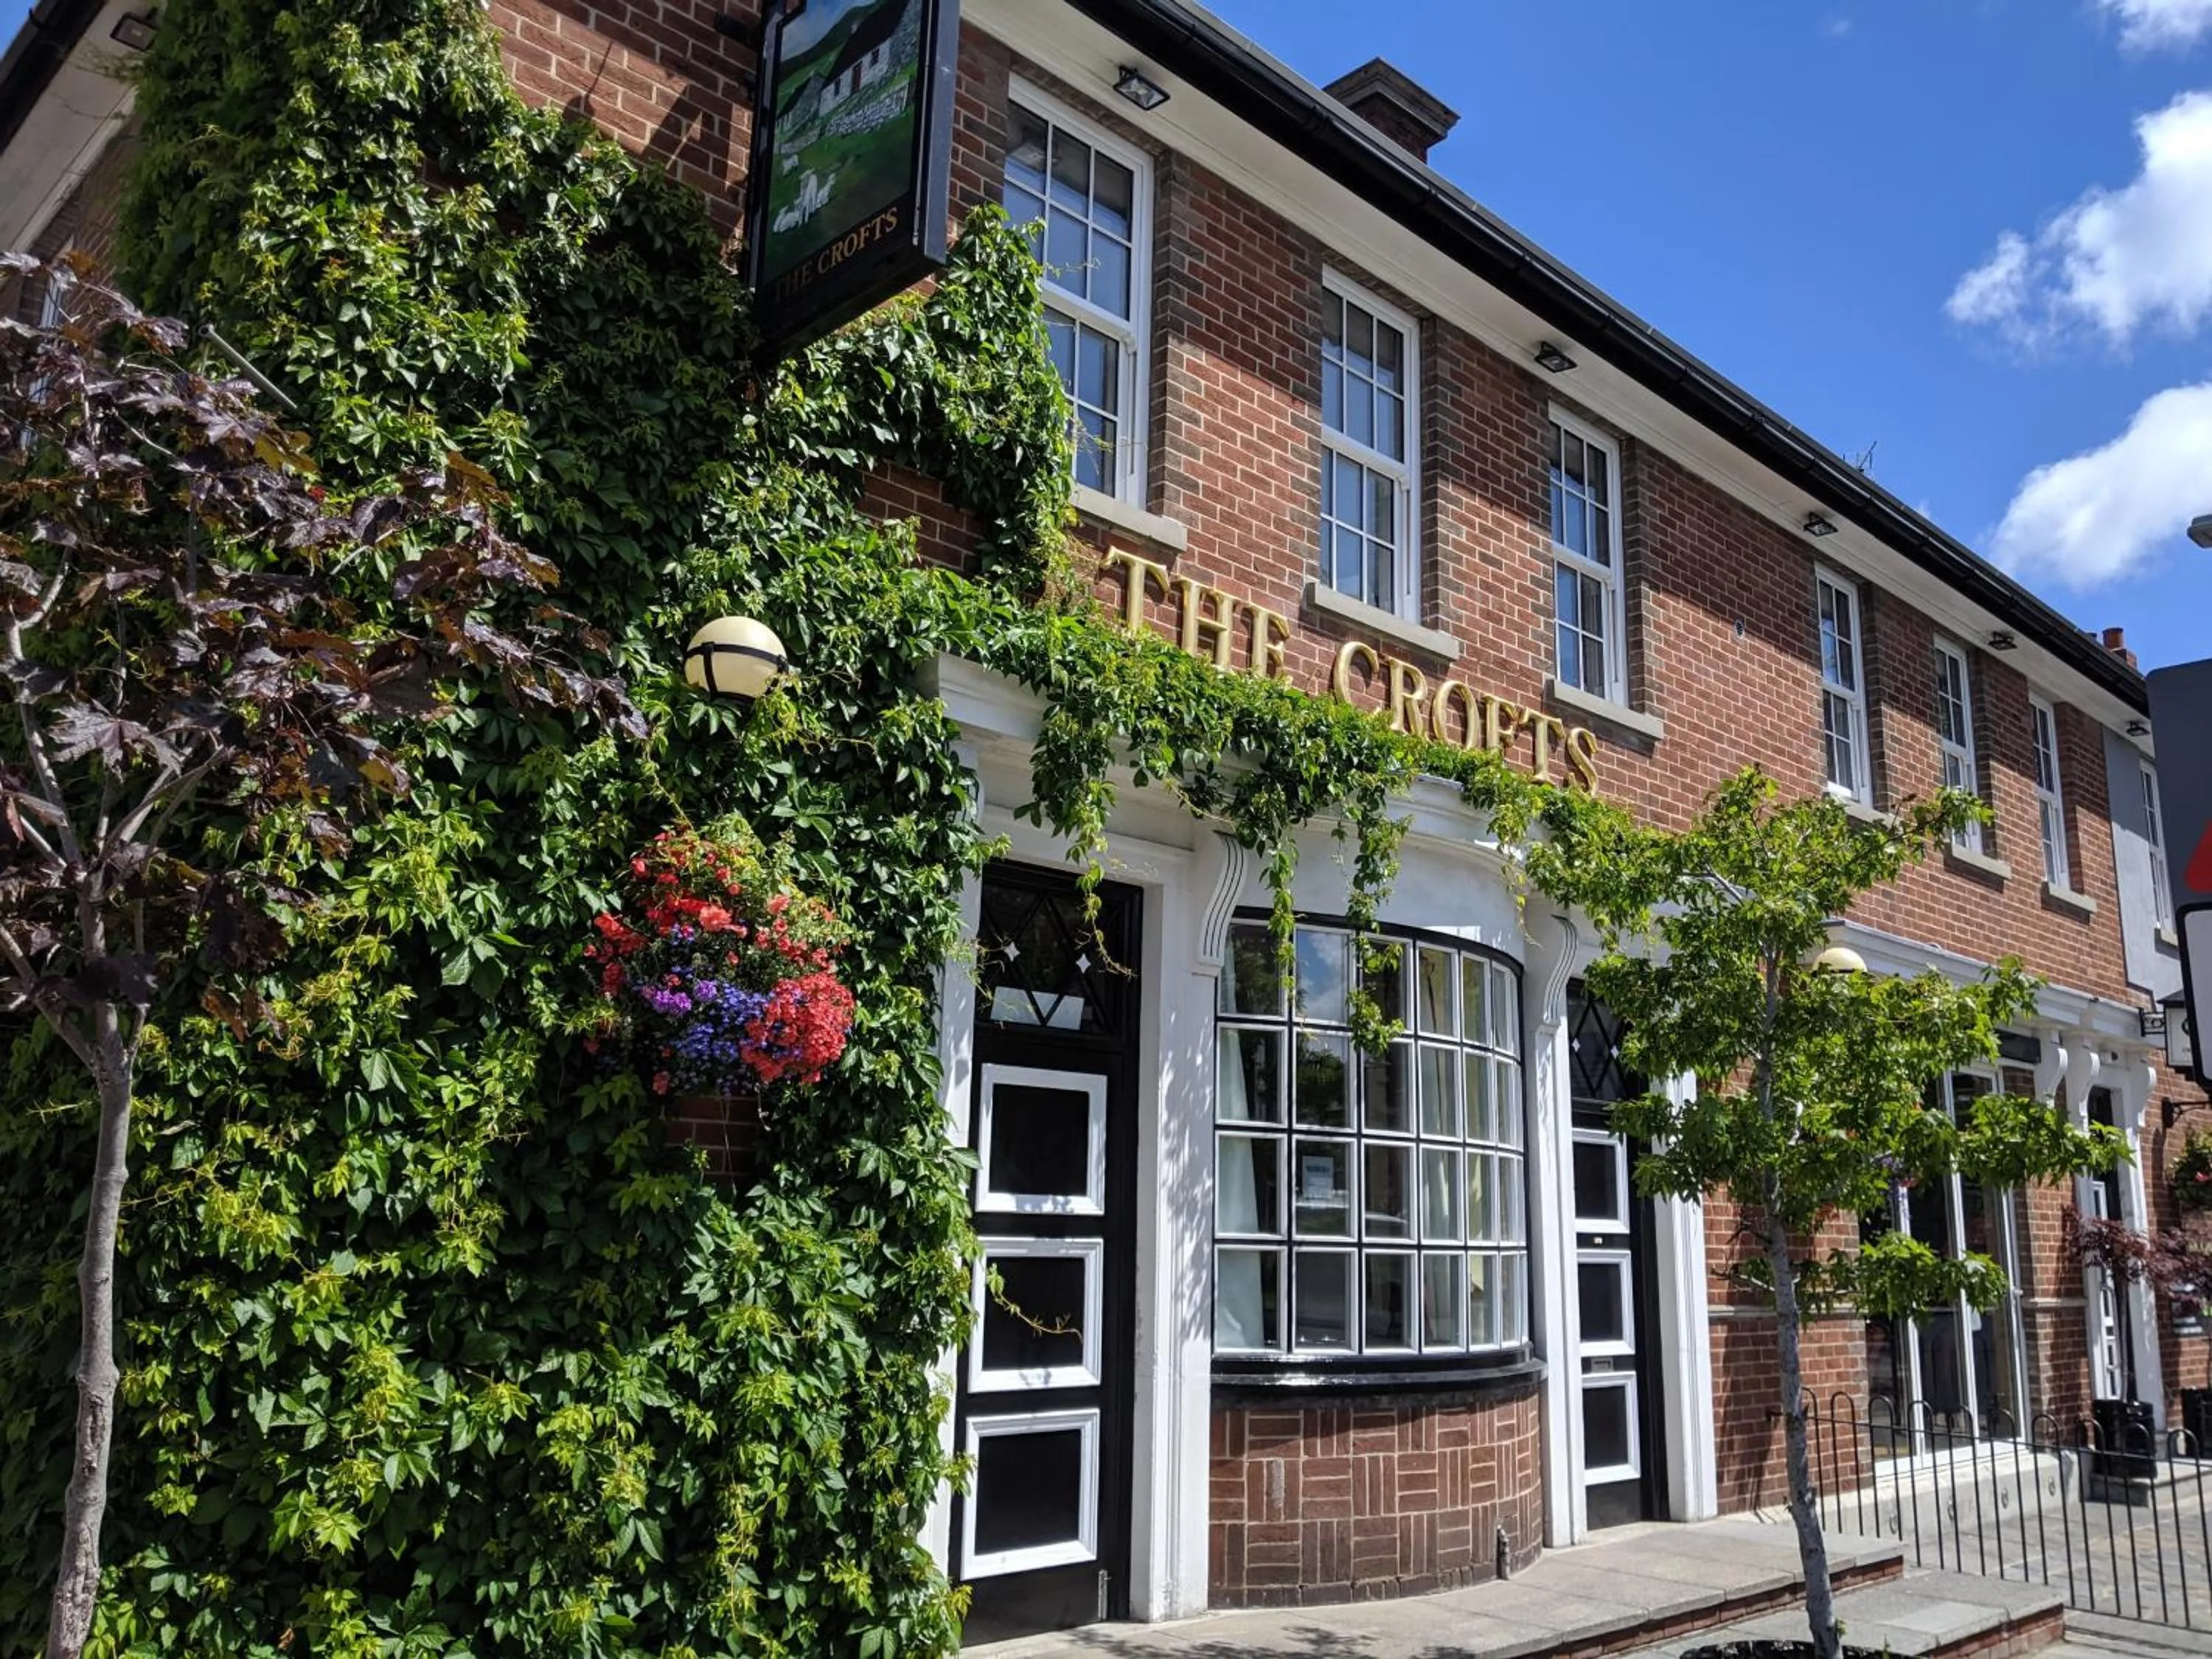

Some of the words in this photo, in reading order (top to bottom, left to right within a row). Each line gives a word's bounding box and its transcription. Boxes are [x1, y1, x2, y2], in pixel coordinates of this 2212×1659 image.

[773, 260, 812, 302] THE
[818, 207, 897, 274] CROFTS
[1098, 546, 1293, 678] THE
[1334, 641, 1599, 797] CROFTS
